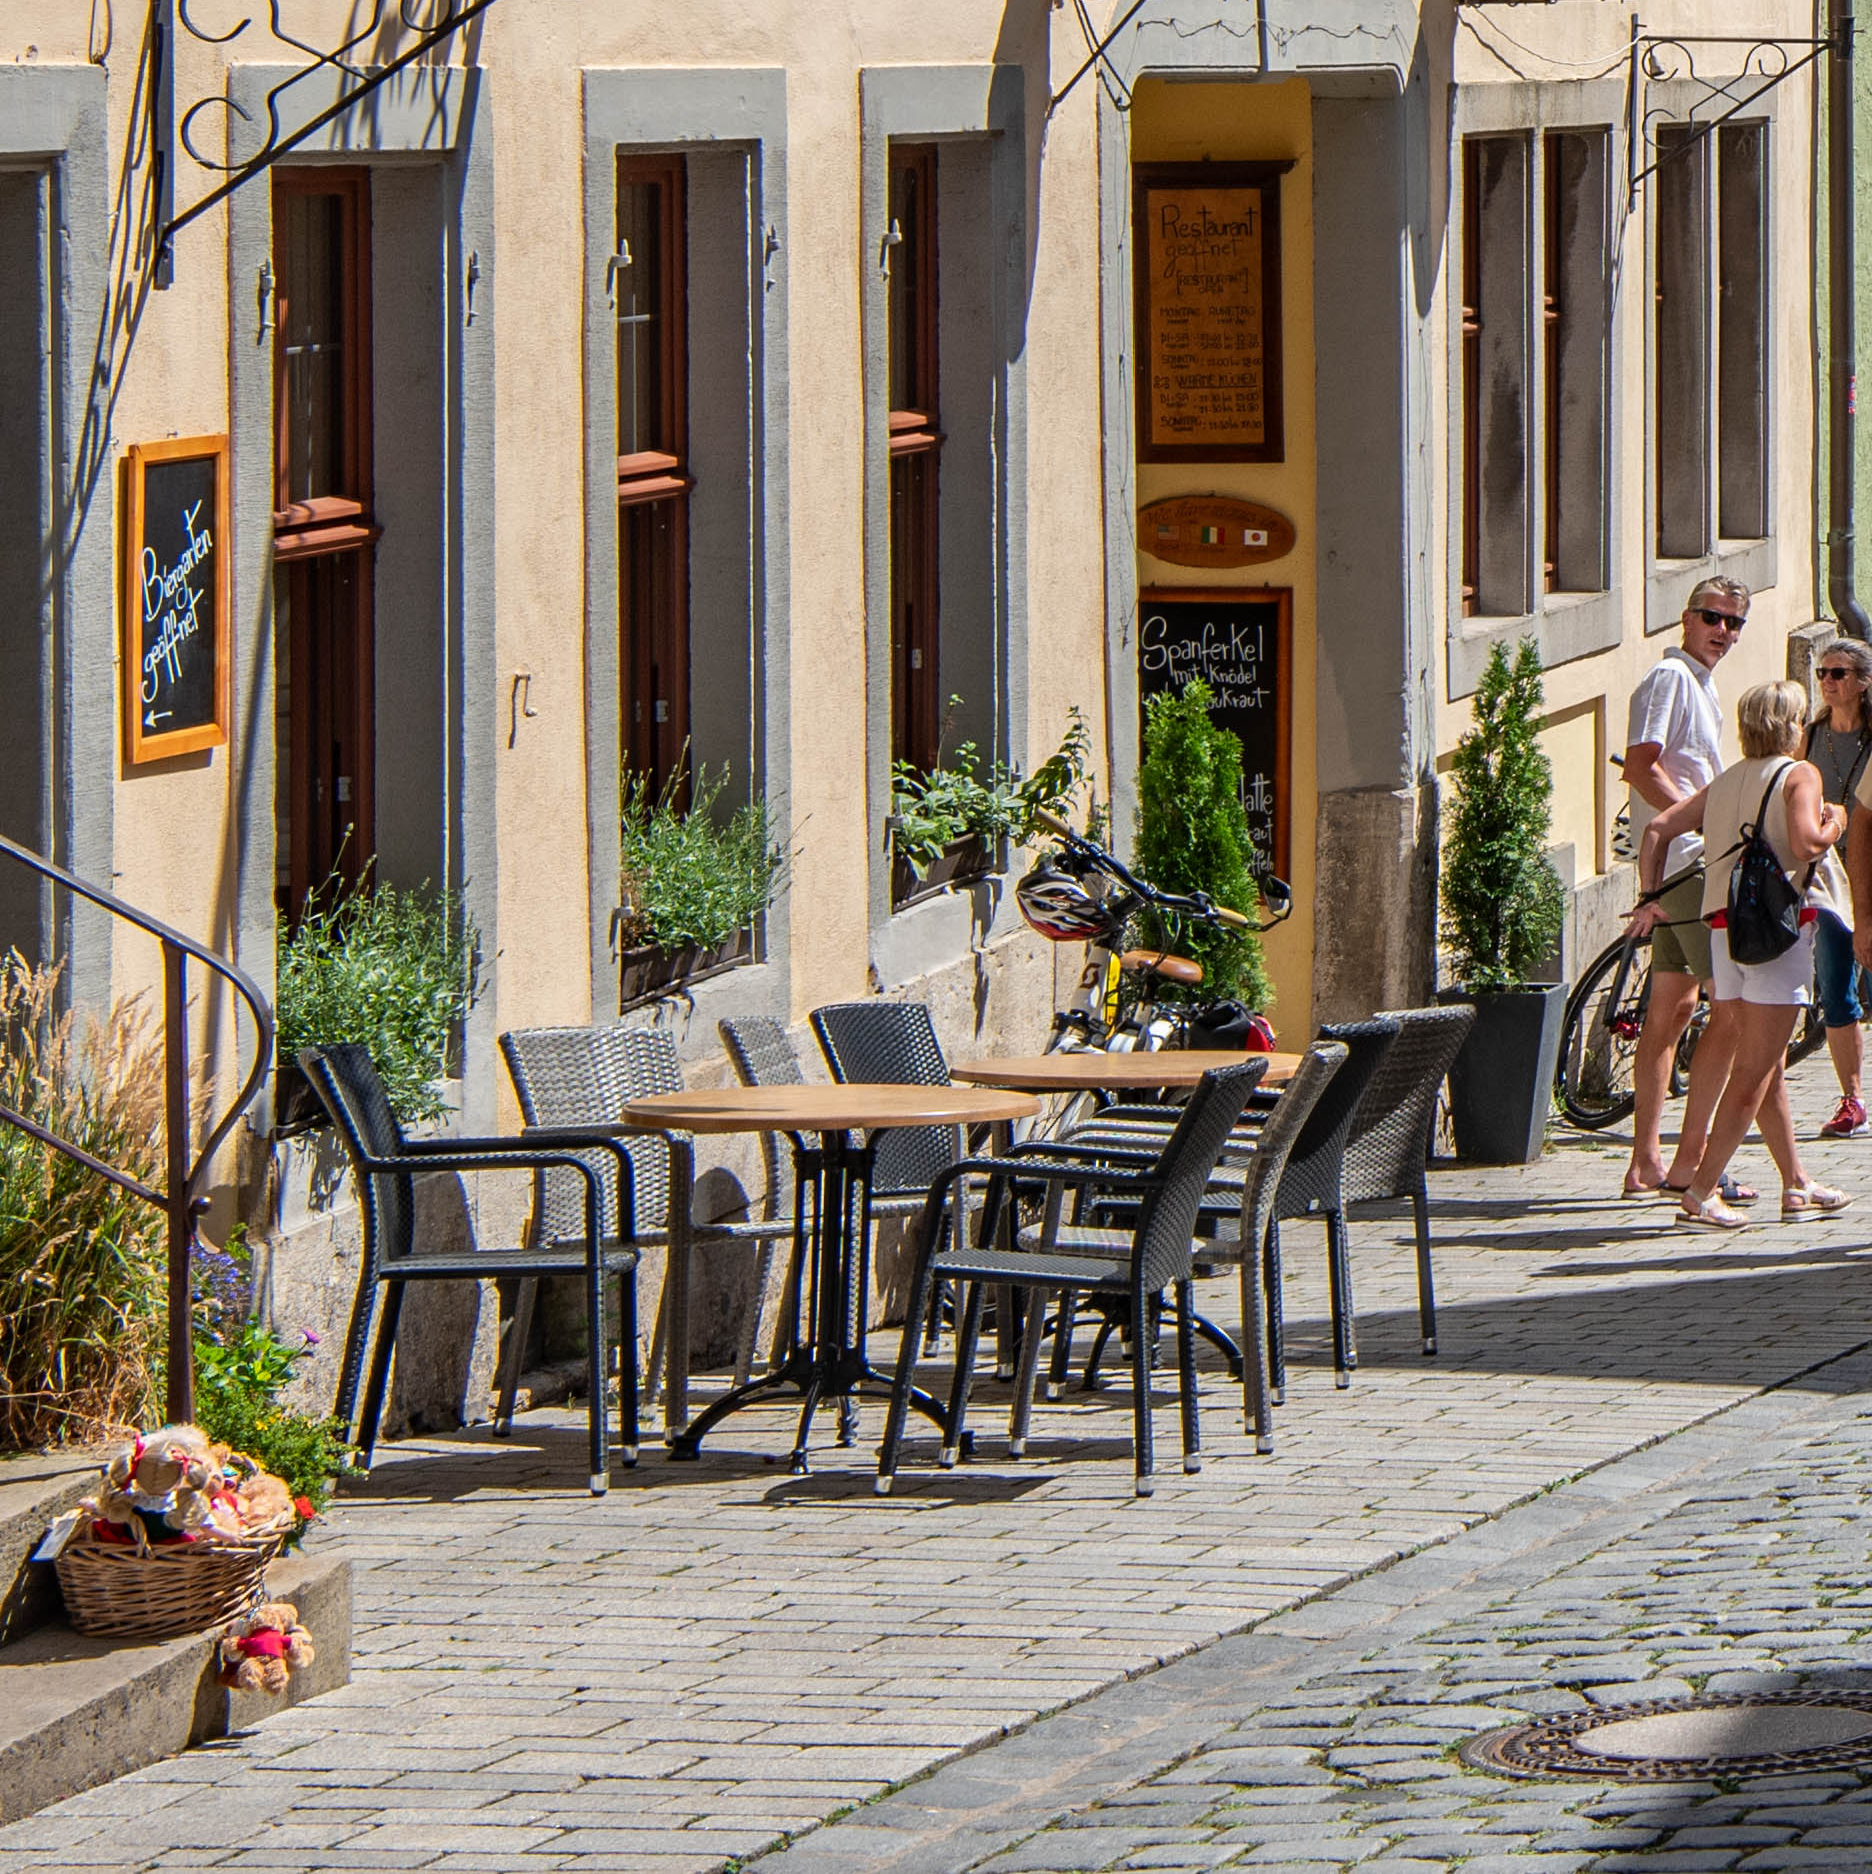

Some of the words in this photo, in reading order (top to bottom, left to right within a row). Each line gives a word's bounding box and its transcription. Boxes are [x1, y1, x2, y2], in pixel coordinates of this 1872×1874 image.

[1161, 204, 1259, 238] Restaurant
[140, 498, 214, 623] Biergarten
[141, 588, 205, 704] geöffnet
[1173, 663, 1201, 686] mit
[1208, 662, 1257, 686] Knödel
